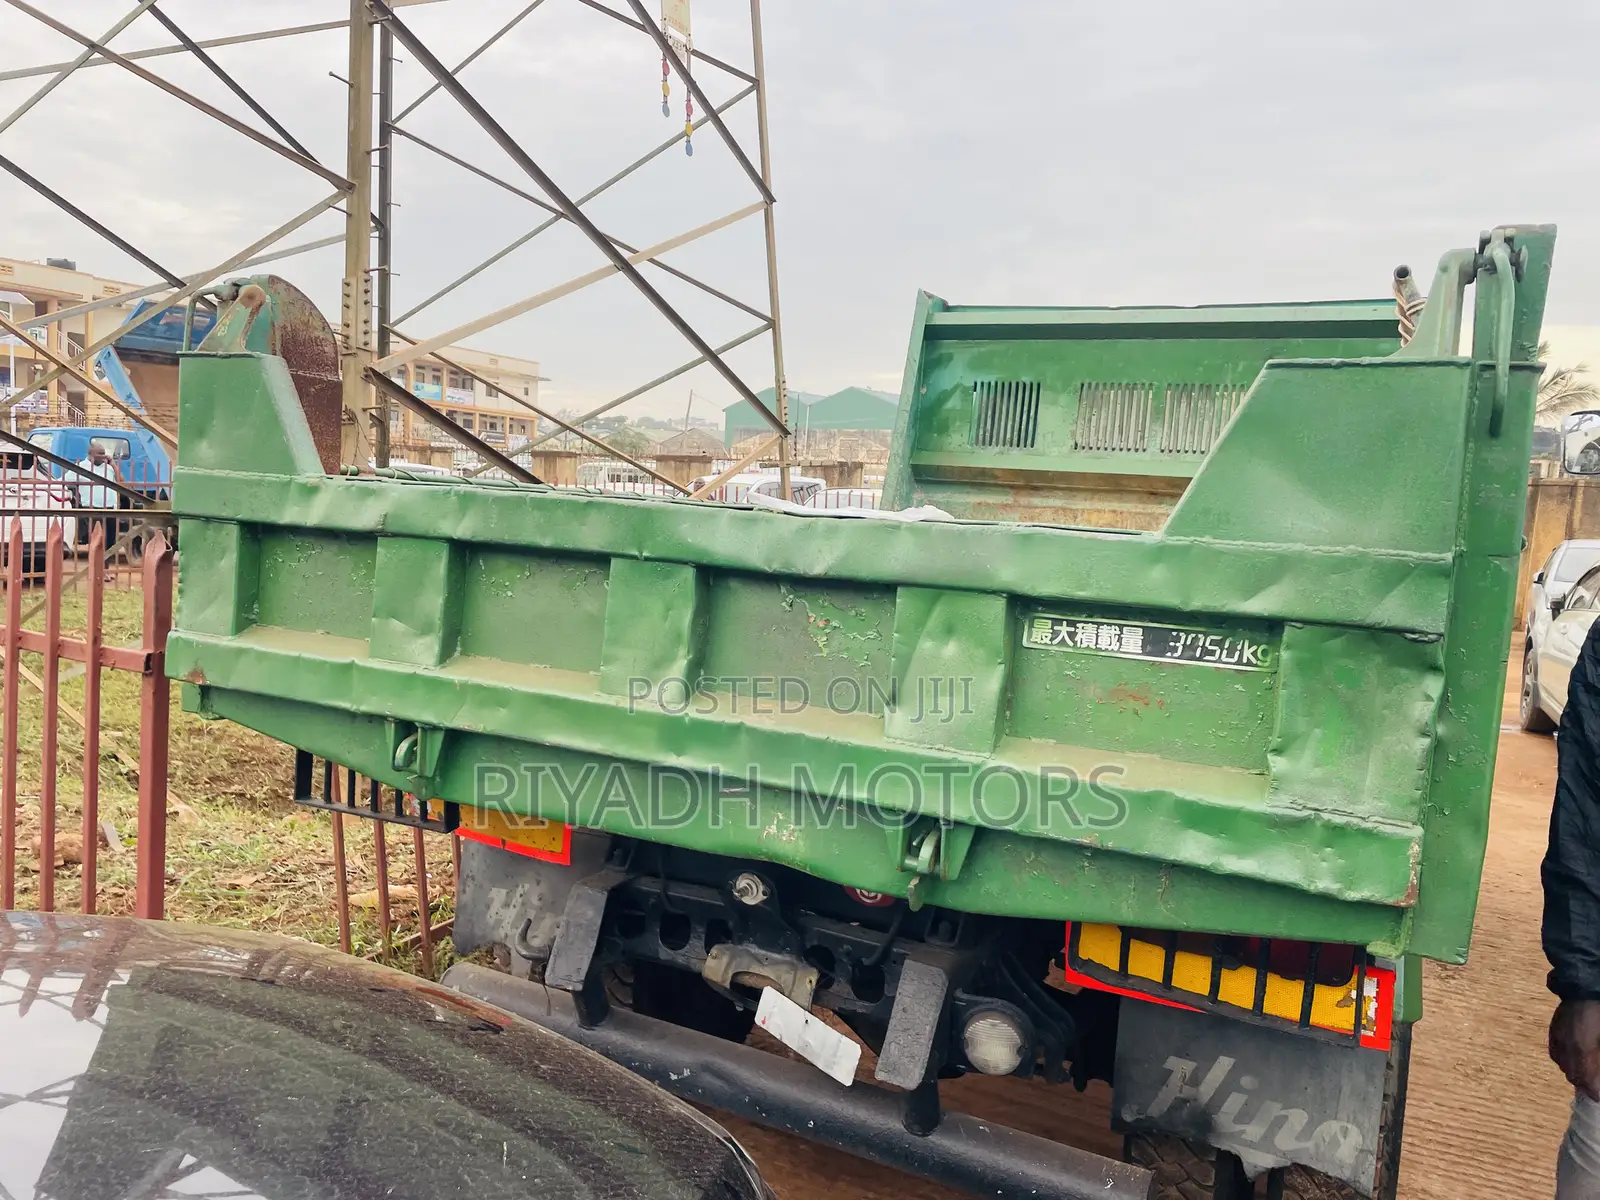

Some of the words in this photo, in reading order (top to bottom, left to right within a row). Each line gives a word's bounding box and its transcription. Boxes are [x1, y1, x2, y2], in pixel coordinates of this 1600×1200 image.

[1031, 618, 1144, 655] 最大積載量
[1121, 1055, 1364, 1162] Hino
